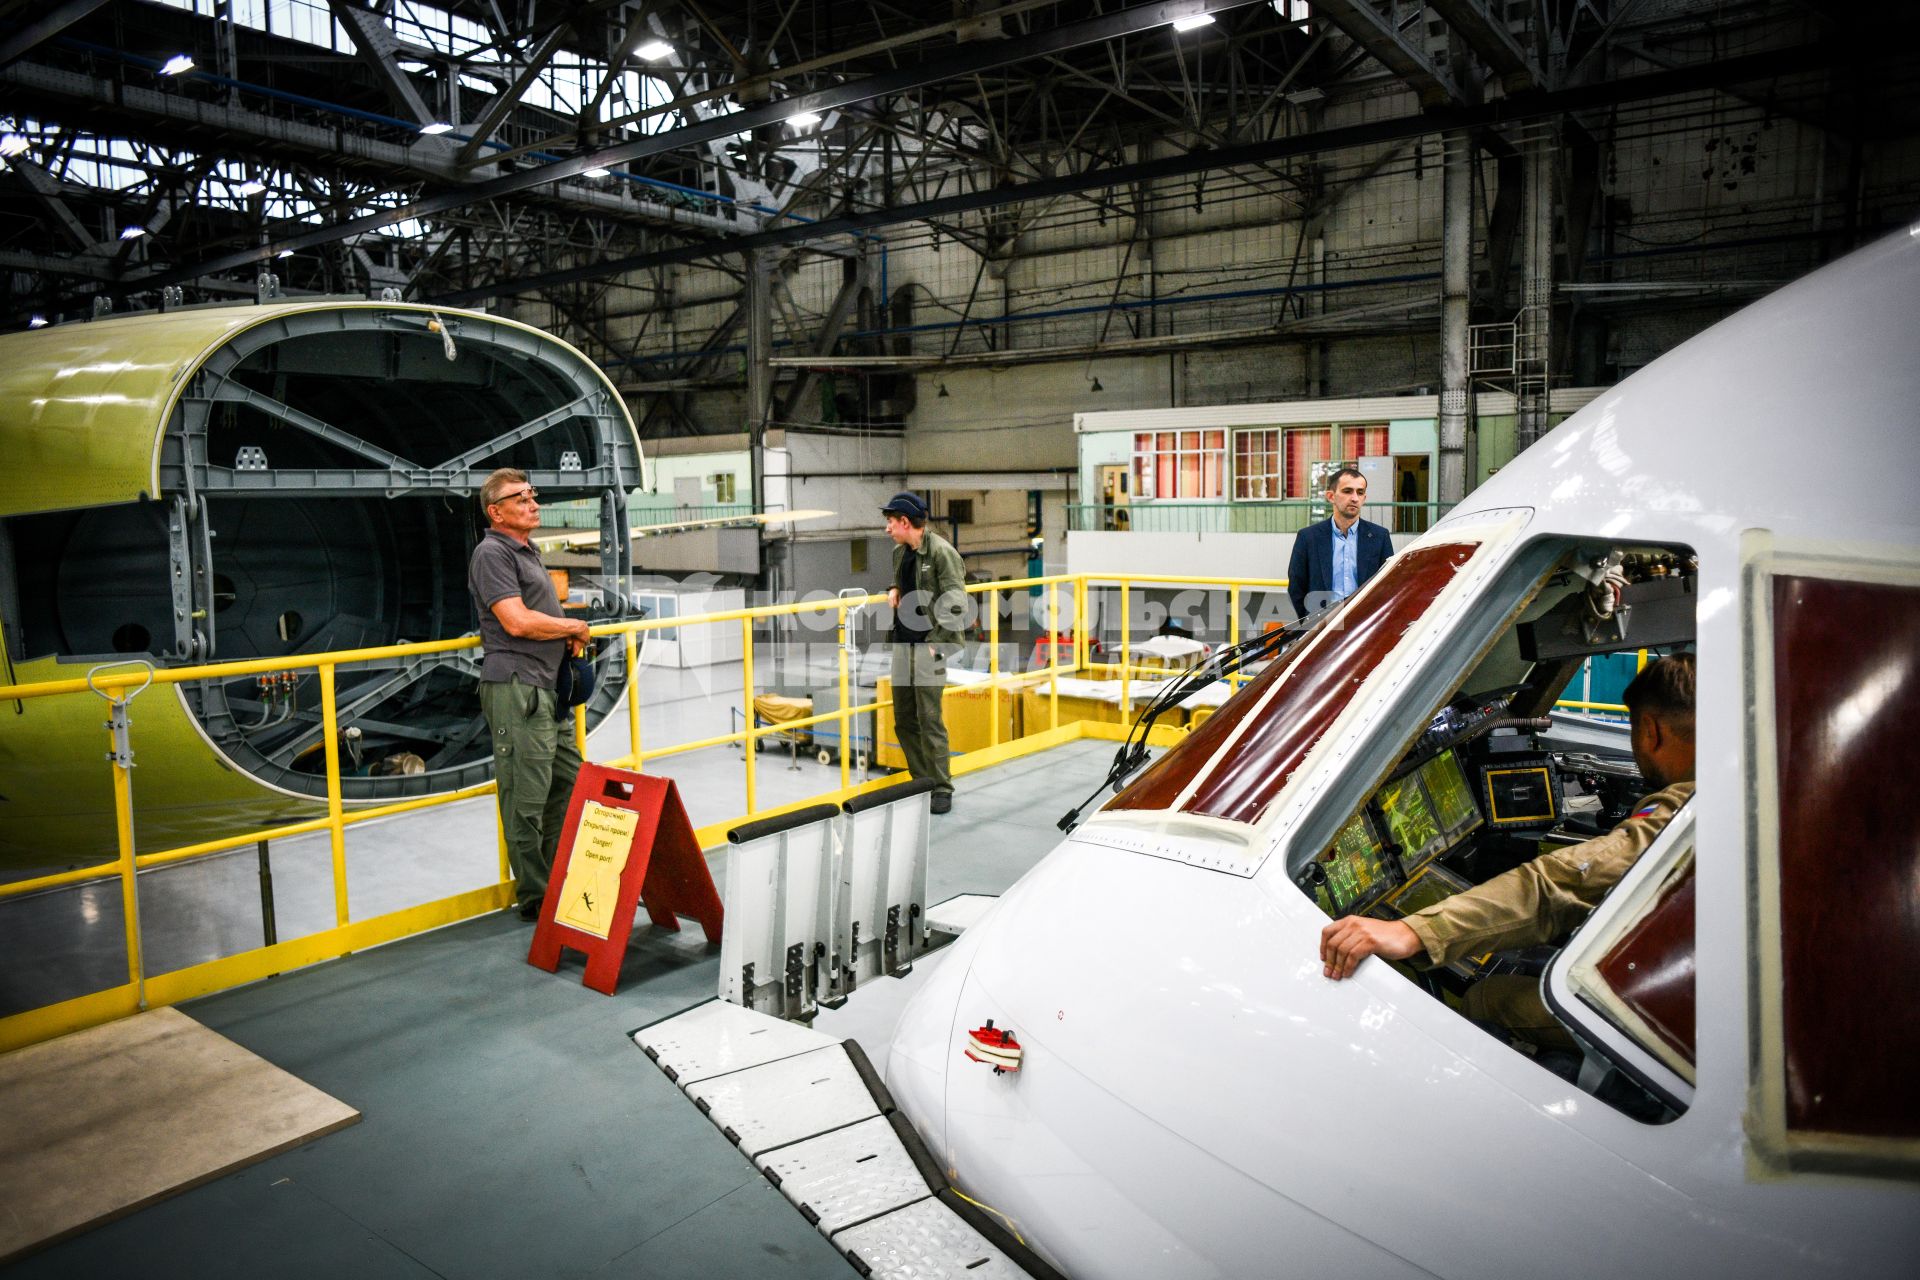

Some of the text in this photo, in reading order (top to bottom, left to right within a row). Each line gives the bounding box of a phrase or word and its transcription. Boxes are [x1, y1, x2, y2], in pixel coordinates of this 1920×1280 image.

[594, 807, 626, 821] Осторожно!
[583, 819, 609, 832] Открытый
[592, 837, 613, 848] Danger!
[585, 849, 613, 864] Open port!
